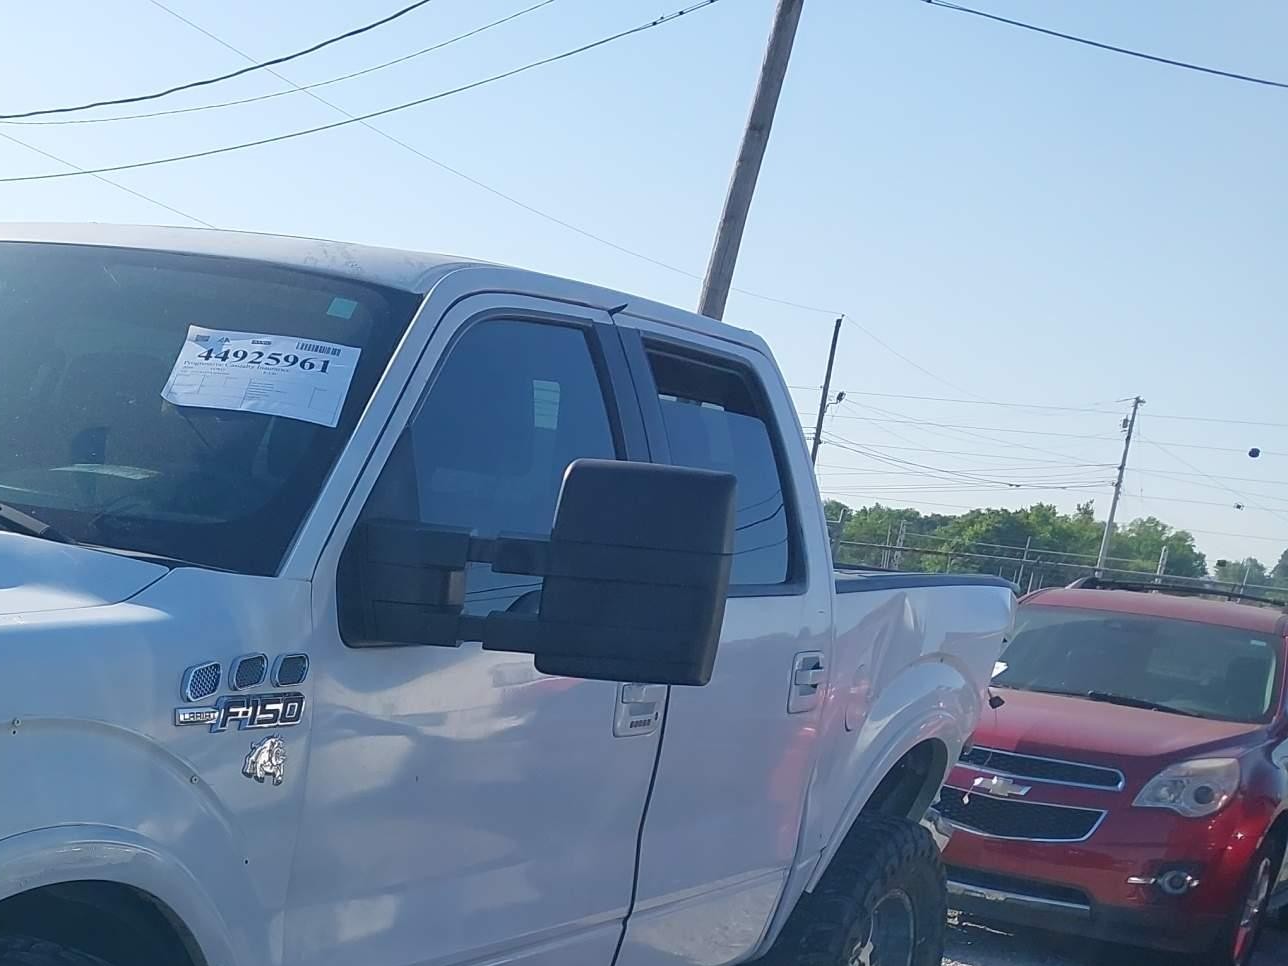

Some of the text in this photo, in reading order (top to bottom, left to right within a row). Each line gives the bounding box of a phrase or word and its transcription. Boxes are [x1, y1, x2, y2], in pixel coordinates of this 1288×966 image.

[197, 348, 331, 375] 44925961
[182, 694, 306, 731] LARIAT F-150
